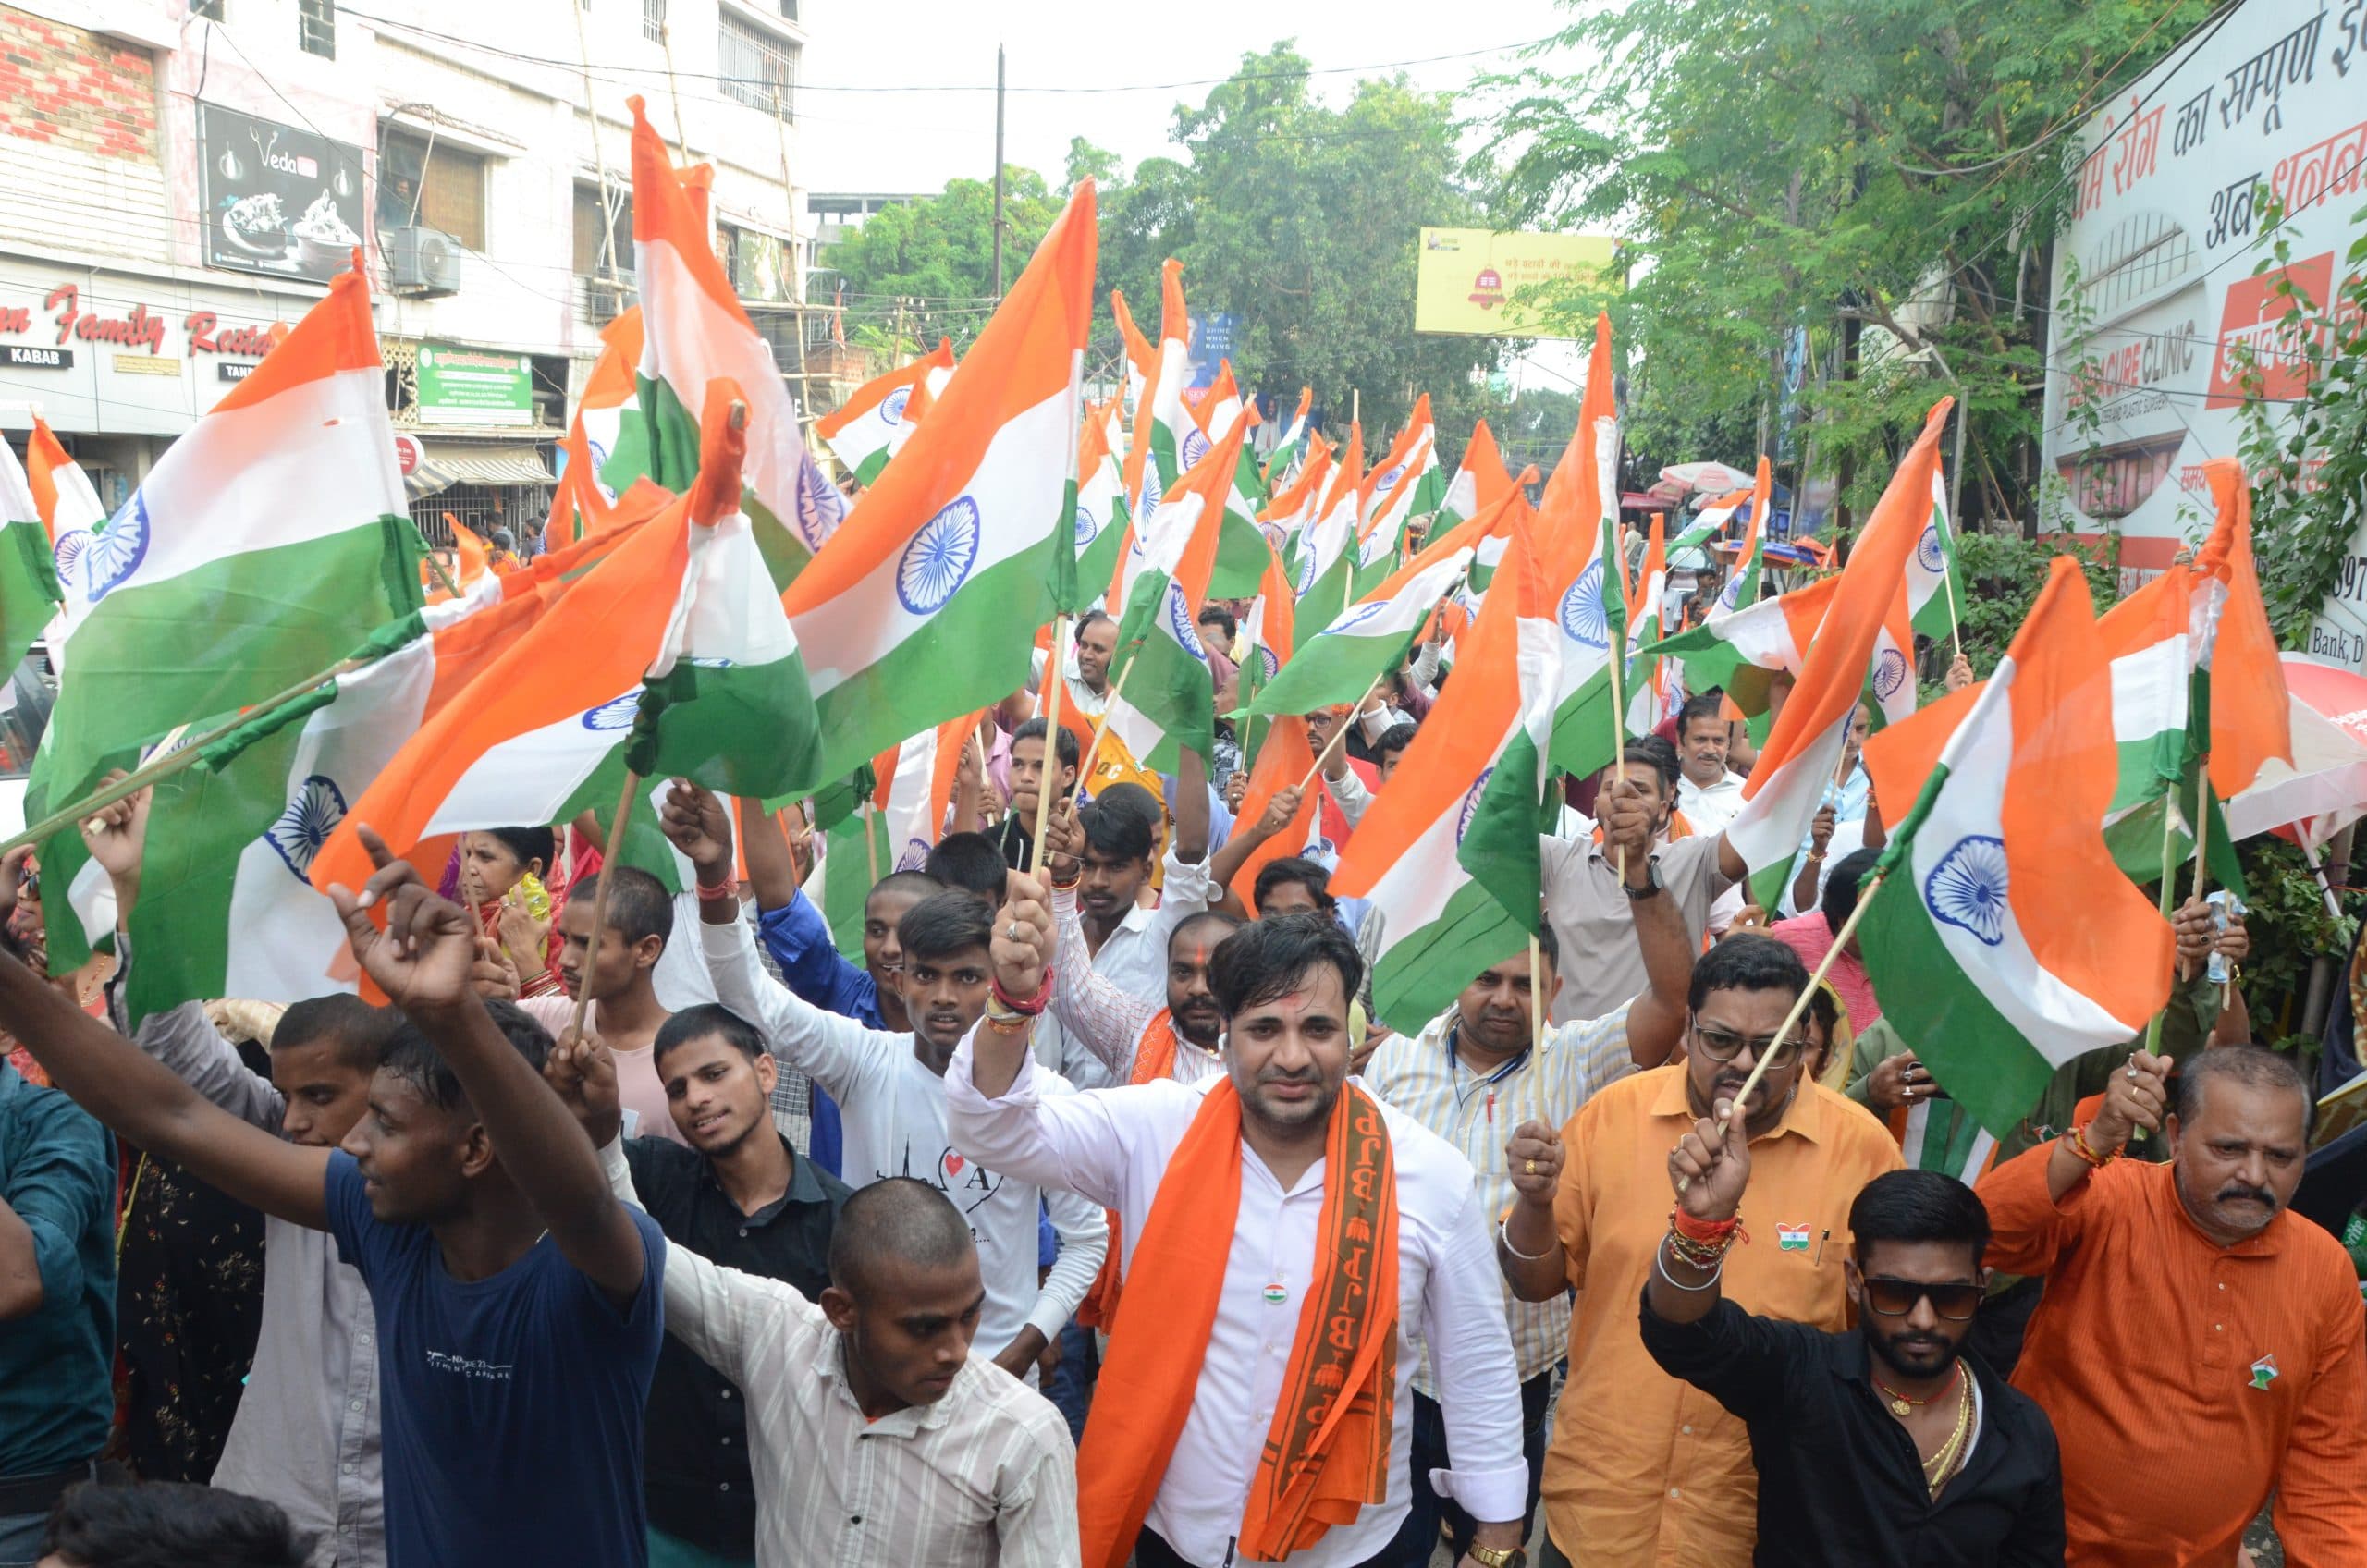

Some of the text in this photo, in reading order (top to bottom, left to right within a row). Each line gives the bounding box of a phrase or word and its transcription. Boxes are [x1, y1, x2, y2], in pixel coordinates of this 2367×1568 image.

[250, 125, 298, 174] Veda
[2113, 94, 2166, 196] रोग
[2173, 84, 2215, 157] का
[2206, 120, 2367, 249] अब धनब
[44, 283, 166, 355] Family
[184, 311, 274, 357] Resta
[2142, 319, 2196, 386] CLINIC
[10, 348, 60, 365] KABAB
[2312, 626, 2349, 666] Bank,
